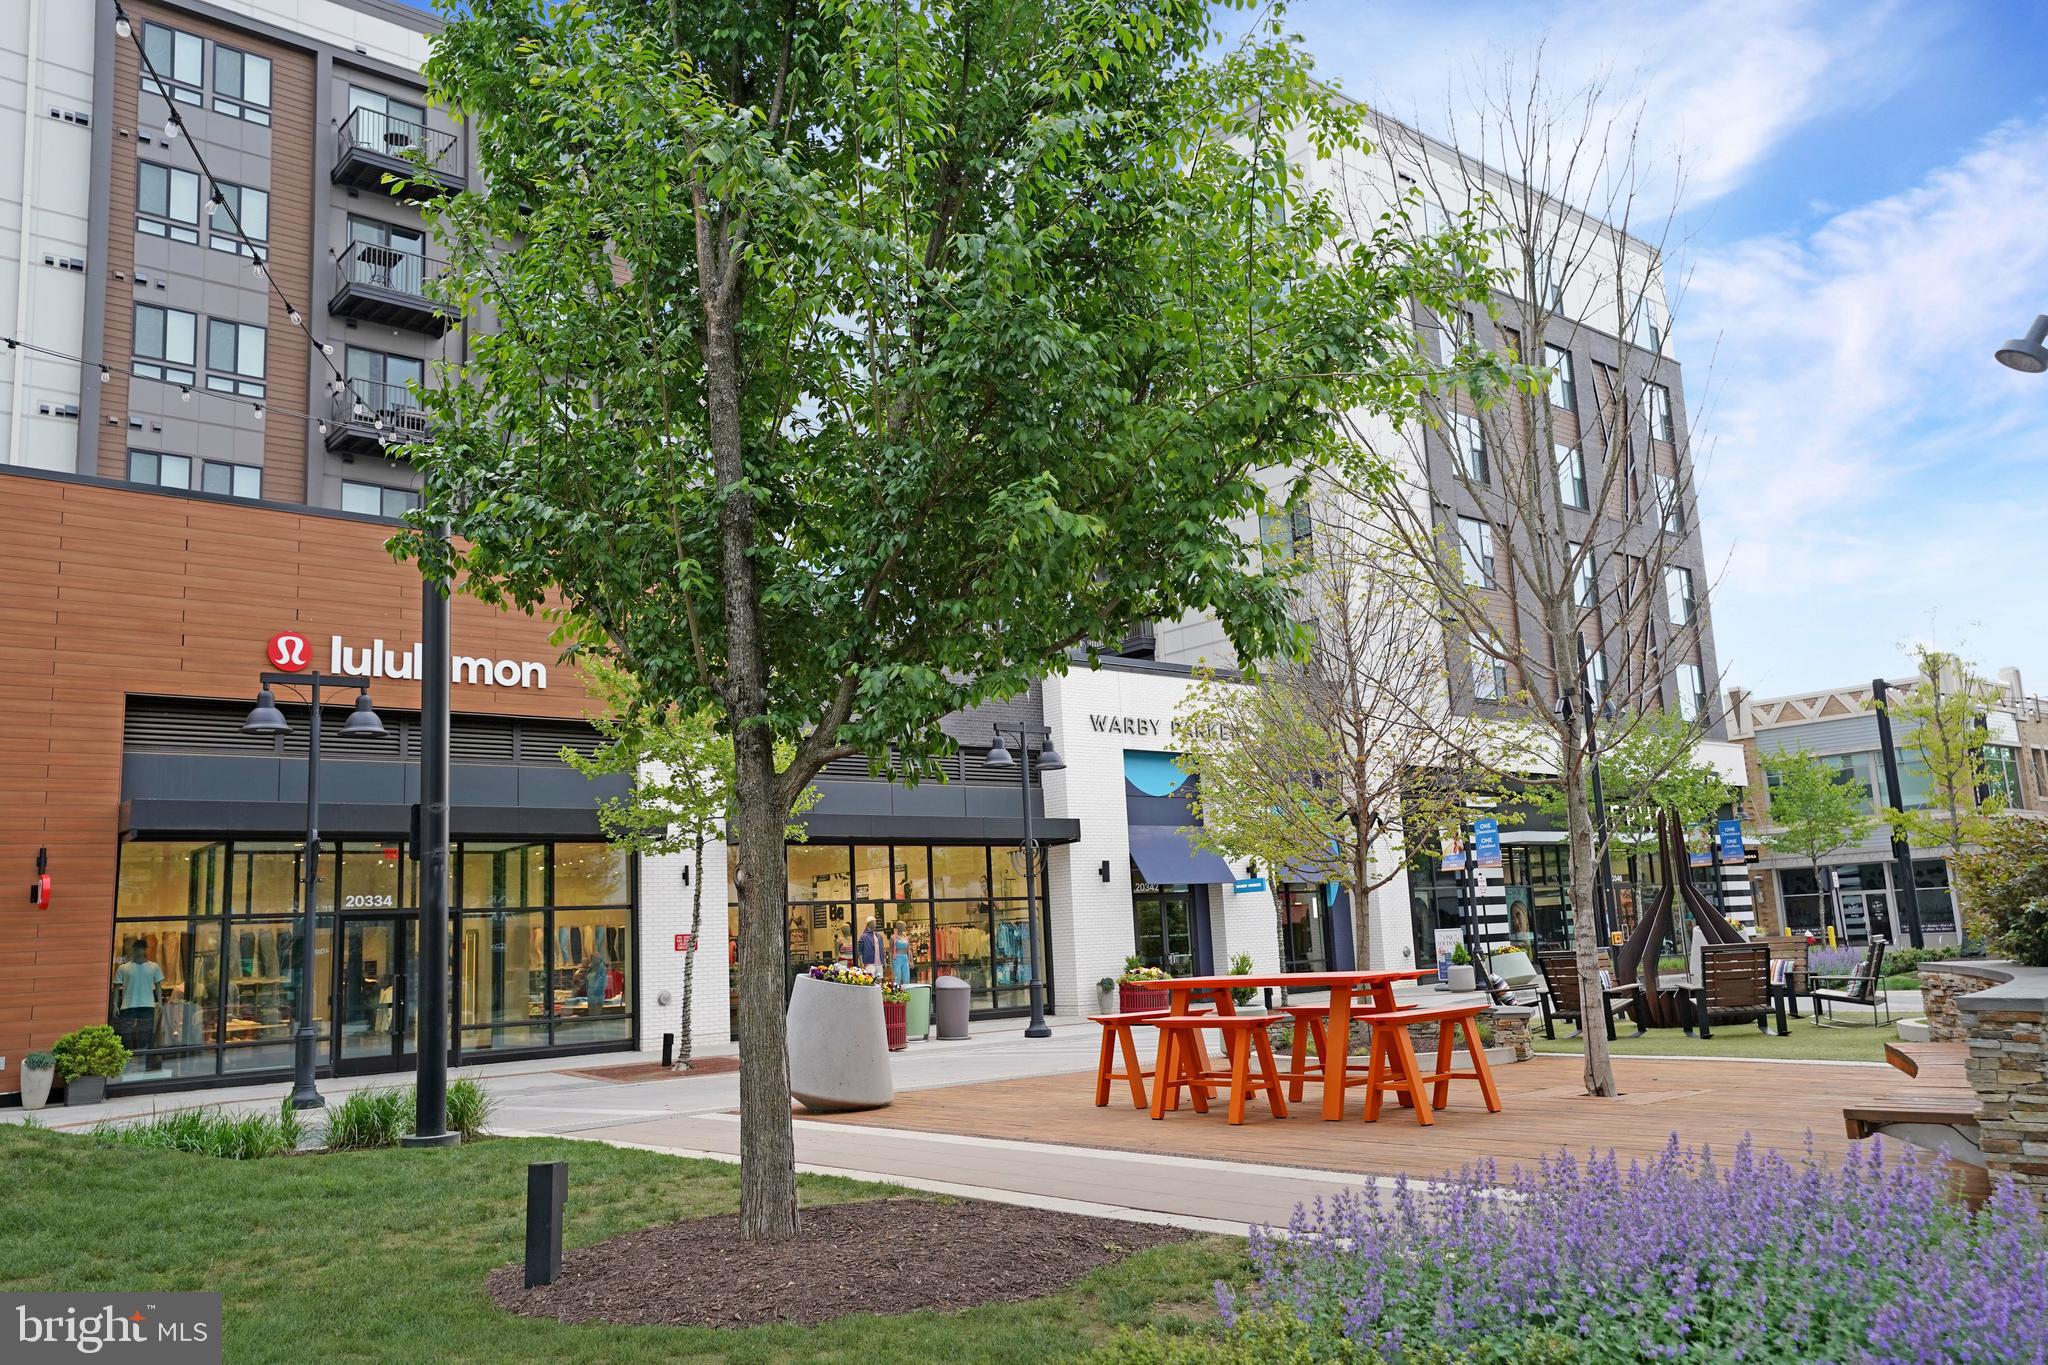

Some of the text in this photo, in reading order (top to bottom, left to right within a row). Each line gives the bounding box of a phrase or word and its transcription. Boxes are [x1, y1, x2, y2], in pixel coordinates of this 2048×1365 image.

[331, 635, 547, 689] lululmon
[1089, 714, 1236, 742] WARBY PRKE
[1135, 883, 1160, 892] 20342
[345, 895, 393, 907] 20334
